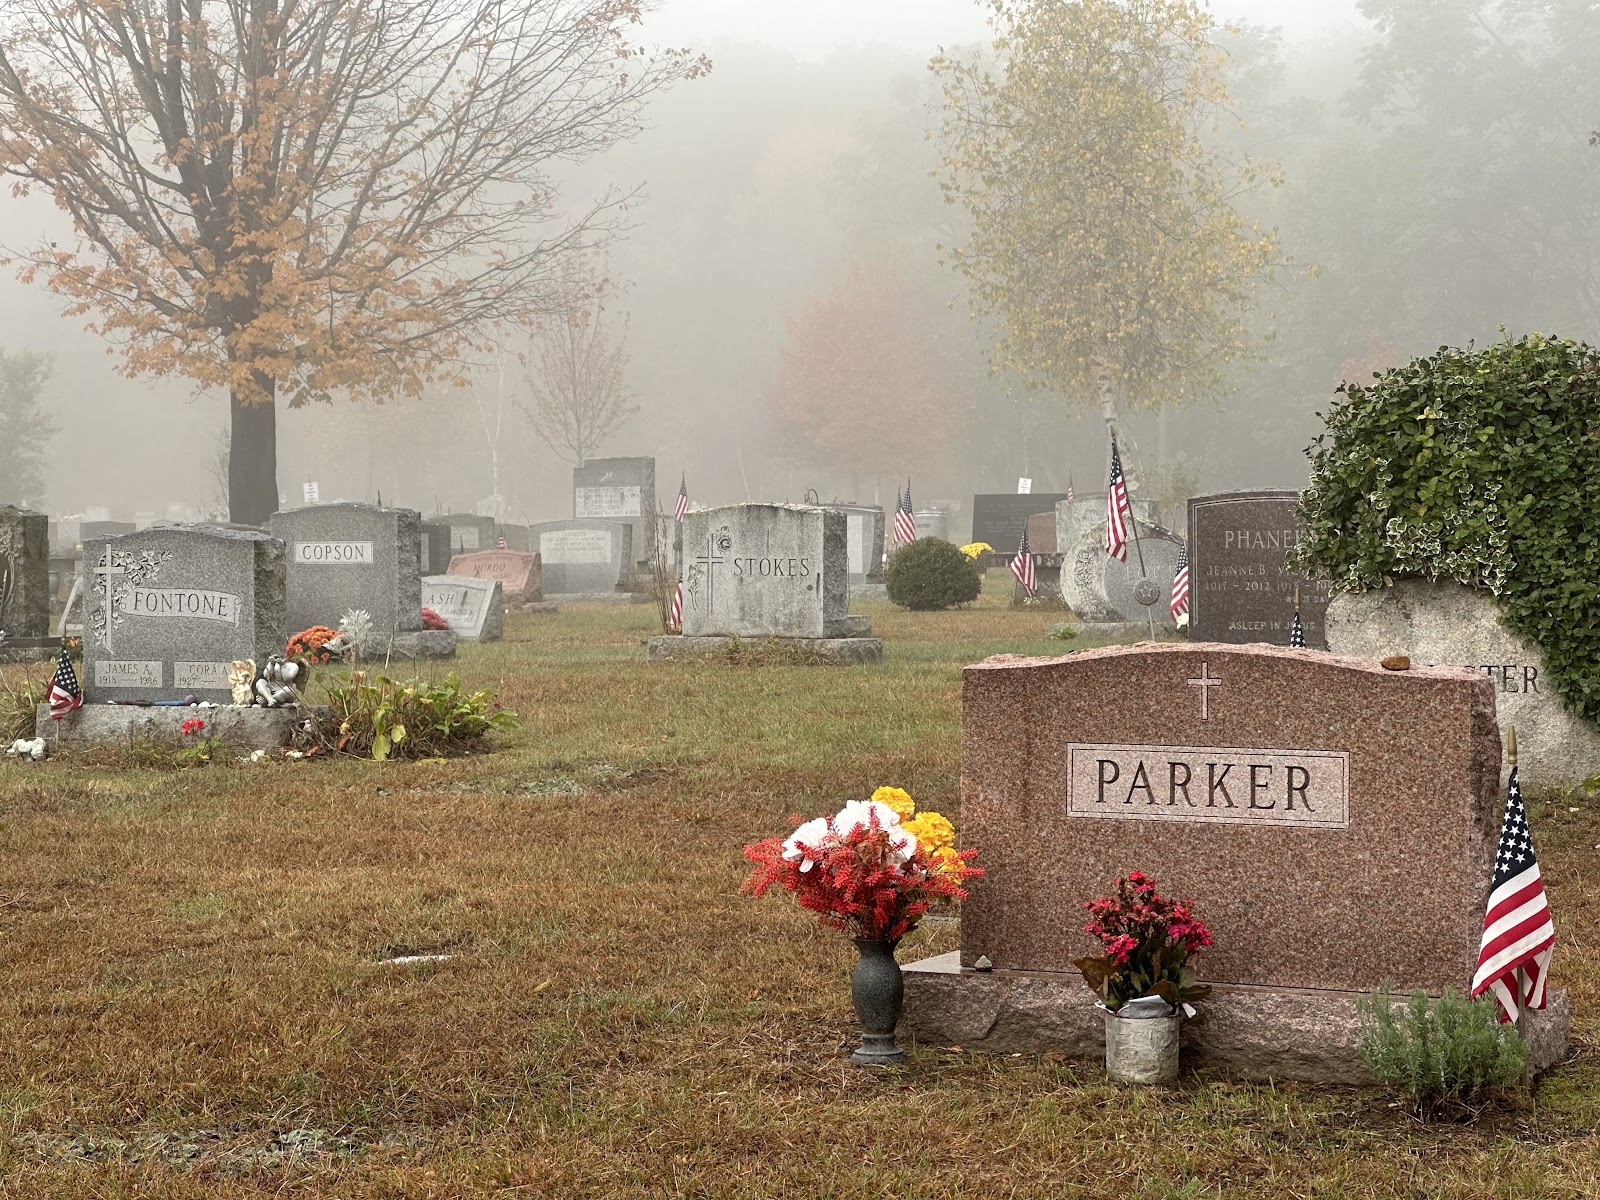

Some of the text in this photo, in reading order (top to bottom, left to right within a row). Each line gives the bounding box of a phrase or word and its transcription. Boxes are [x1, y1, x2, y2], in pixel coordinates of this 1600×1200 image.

[302, 545, 364, 560] COPSON
[472, 562, 507, 572] MURDO
[733, 557, 810, 577] STOKES
[1206, 564, 1255, 576] JEANNE
[1259, 564, 1266, 575] B
[1245, 581, 1270, 591] 2012
[133, 591, 228, 617] FONTONE
[426, 593, 455, 605] ASH
[1229, 621, 1267, 631] ASLEEP
[1270, 621, 1281, 630] IN
[105, 663, 139, 675] JAMES
[189, 664, 218, 676] CORA
[140, 676, 158, 686] 1986
[177, 677, 197, 686] 1927
[1095, 759, 1317, 813] PARKER
